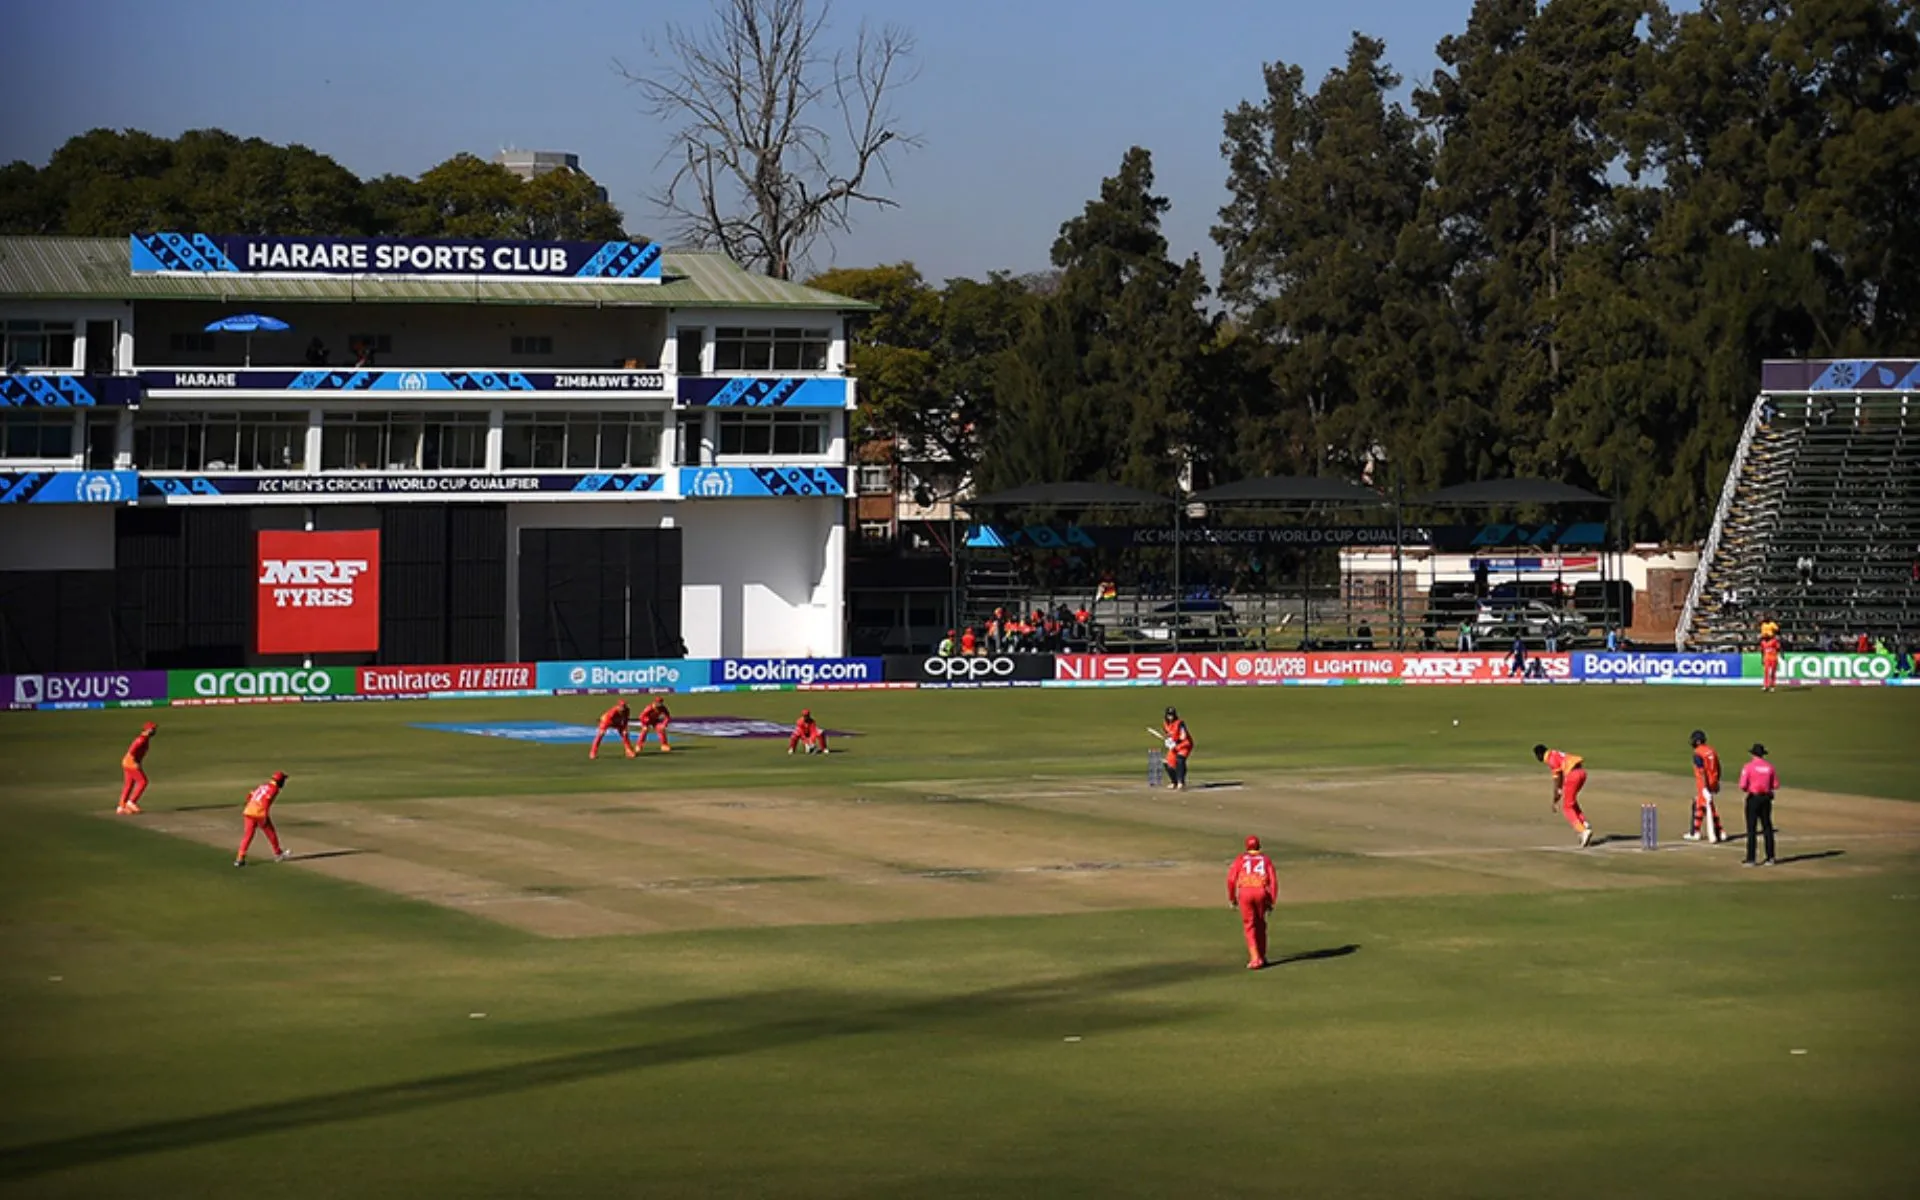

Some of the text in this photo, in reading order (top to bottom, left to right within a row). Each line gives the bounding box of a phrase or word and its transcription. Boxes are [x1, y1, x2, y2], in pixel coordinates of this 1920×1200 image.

[248, 243, 568, 271] HARARE SPORTS CLUB
[175, 373, 236, 387] HARARE
[555, 375, 662, 387] ZIMBABWE 2023
[258, 478, 540, 491] ICC MEN'S CRICKET WORLD CUP QUALIFIER
[1133, 530, 1156, 542] ICC
[1267, 530, 1322, 542] WORLD
[1324, 530, 1355, 542] CUP
[260, 560, 367, 584] MRF
[274, 588, 353, 607] TYRES
[591, 666, 680, 685] BharatPe
[724, 660, 867, 683] Booking.com
[924, 657, 1015, 679] oppo
[1056, 657, 1228, 678] NISSAN
[1314, 660, 1393, 674] LIGHTING
[1401, 658, 1483, 676] MRF
[1584, 654, 1728, 677] Booking.com
[48, 676, 129, 698] BYJU'S
[194, 671, 331, 695] aramco
[363, 668, 530, 690] Emirates FLY BETTER
[1242, 859, 1266, 877] 14
